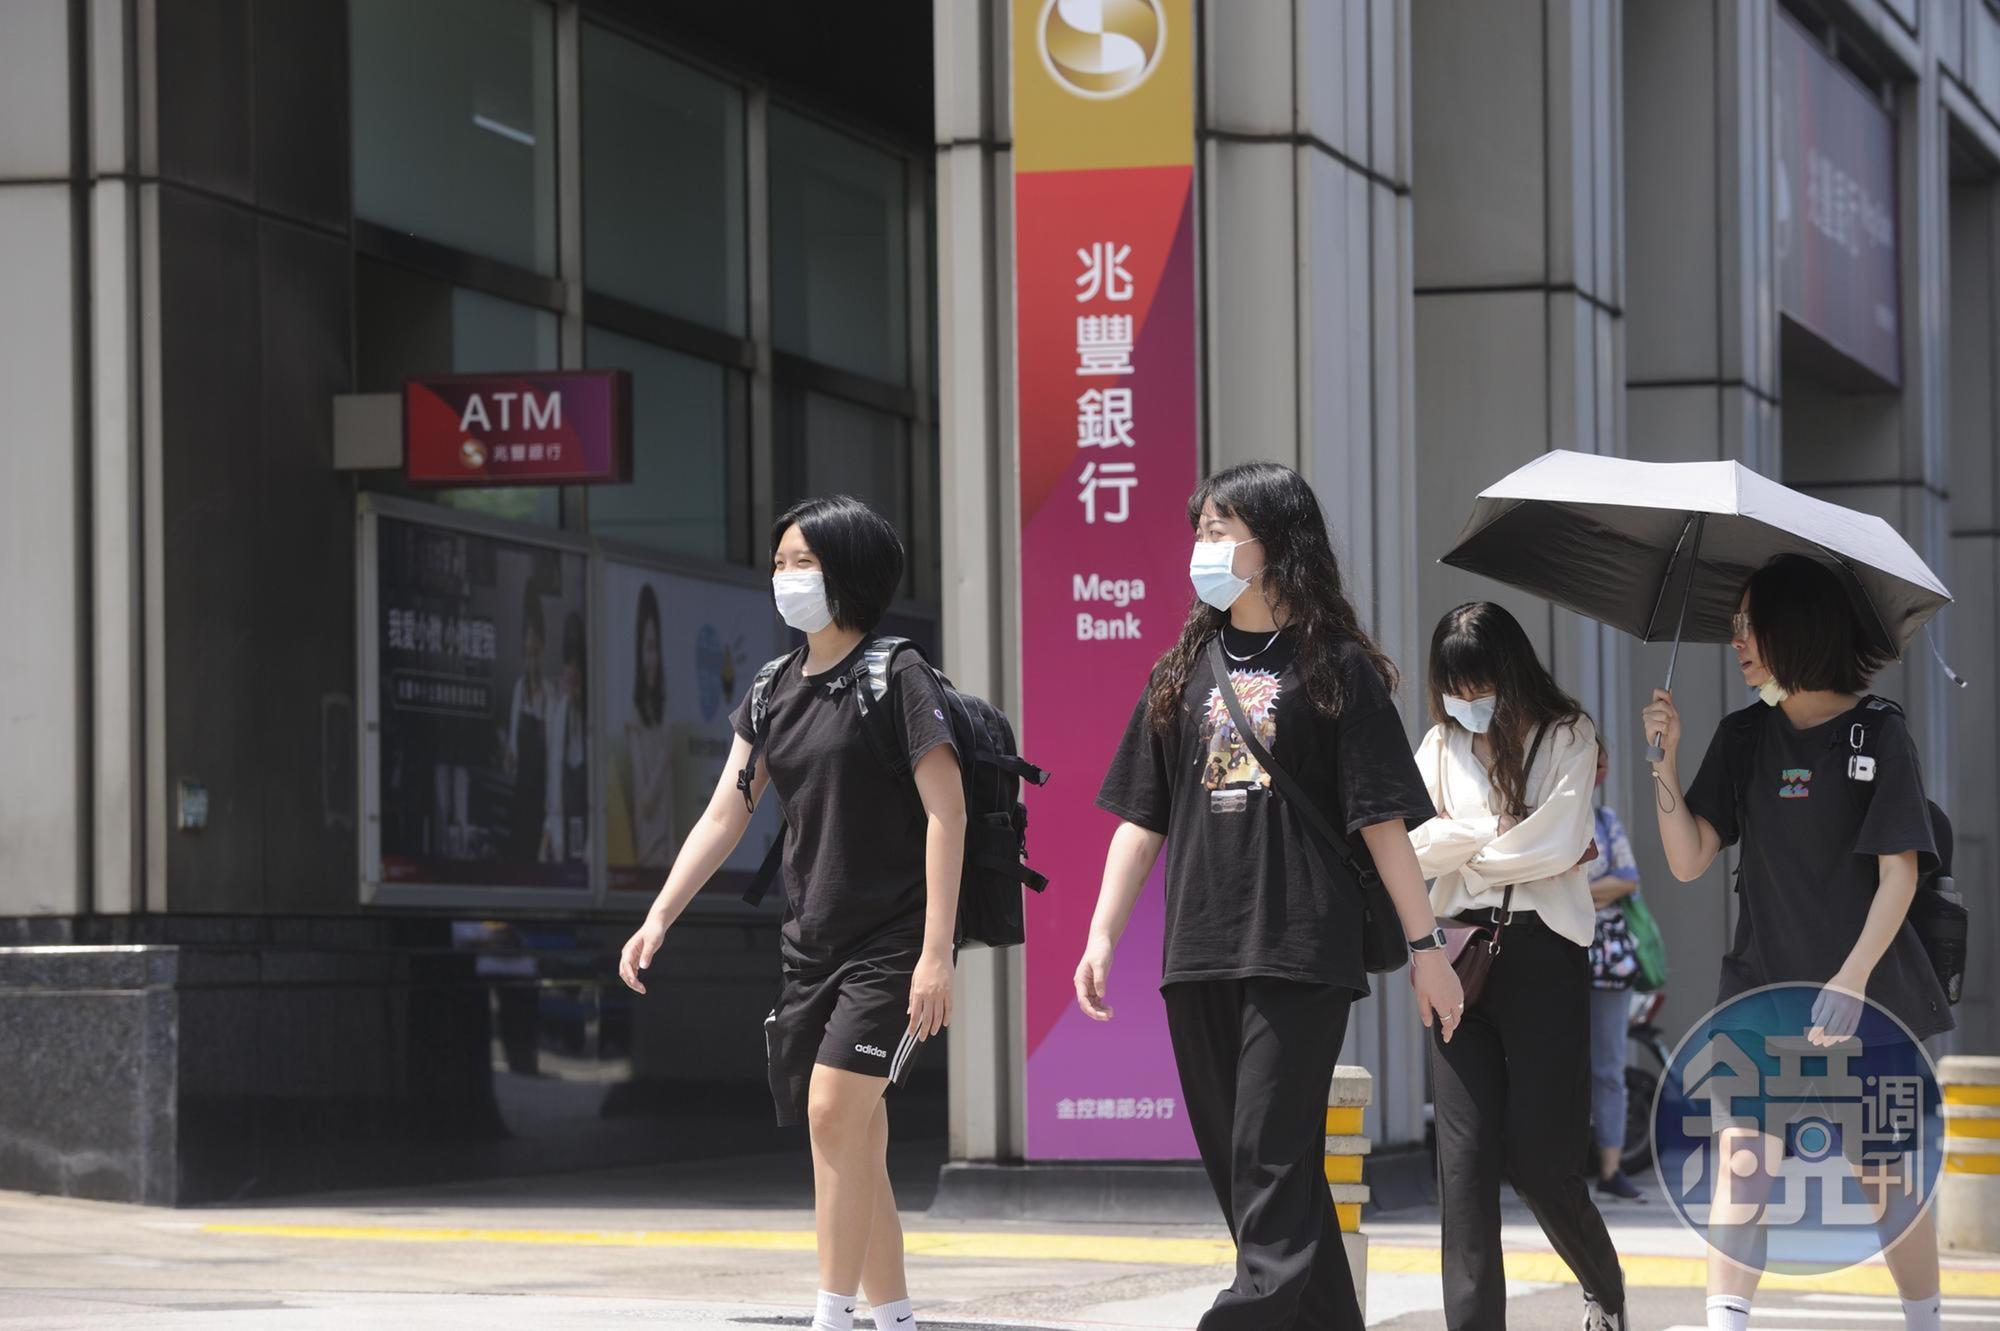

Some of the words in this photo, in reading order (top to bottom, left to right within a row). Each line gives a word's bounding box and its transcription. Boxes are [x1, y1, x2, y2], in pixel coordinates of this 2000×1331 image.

[1075, 241, 1138, 525] 兆豐銀行
[459, 391, 562, 432] ATM
[1073, 573, 1145, 607] Mega
[1076, 612, 1141, 640] Bank
[855, 1043, 887, 1058] adidas
[1056, 1097, 1176, 1120] 金控總部分行
